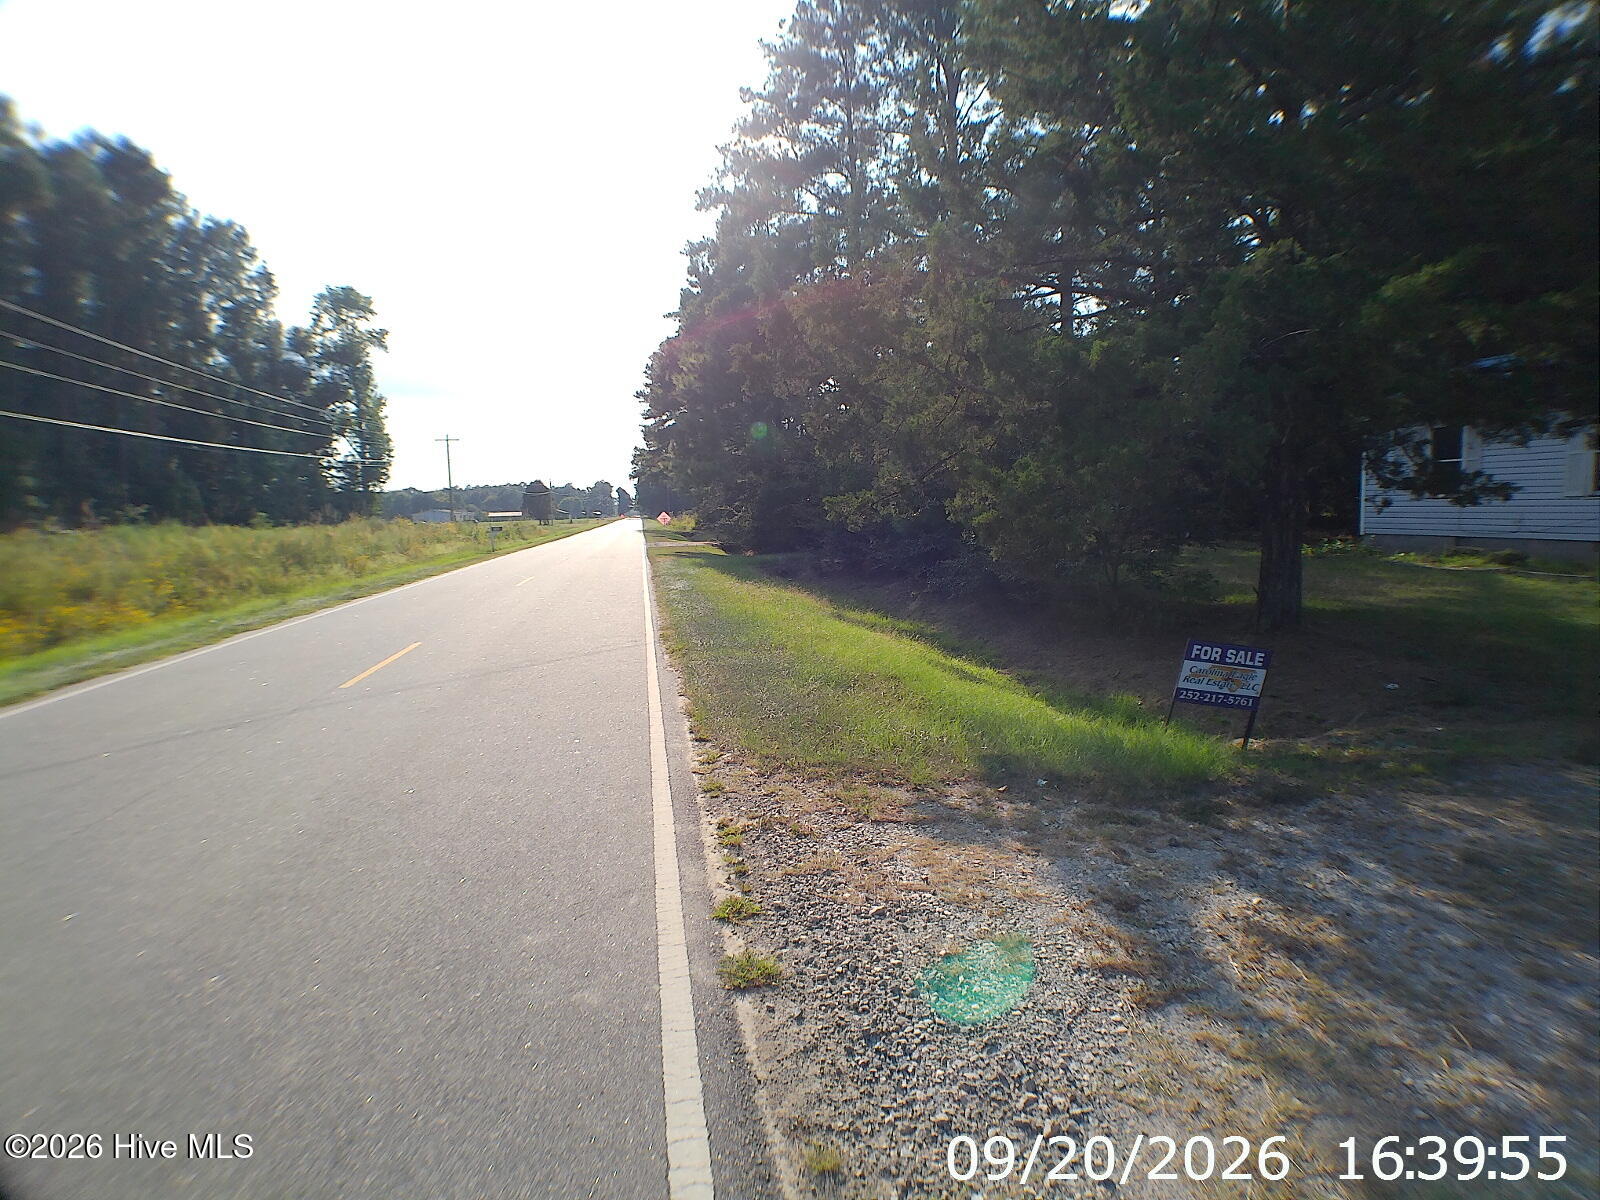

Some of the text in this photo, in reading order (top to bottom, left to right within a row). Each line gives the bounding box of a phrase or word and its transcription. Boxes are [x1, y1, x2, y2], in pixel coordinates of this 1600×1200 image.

[1191, 645, 1265, 666] FOR SALE
[1190, 666, 1230, 679] Carolina
[1183, 675, 1206, 685] Real
[1179, 690, 1254, 706] 252-217-5761
